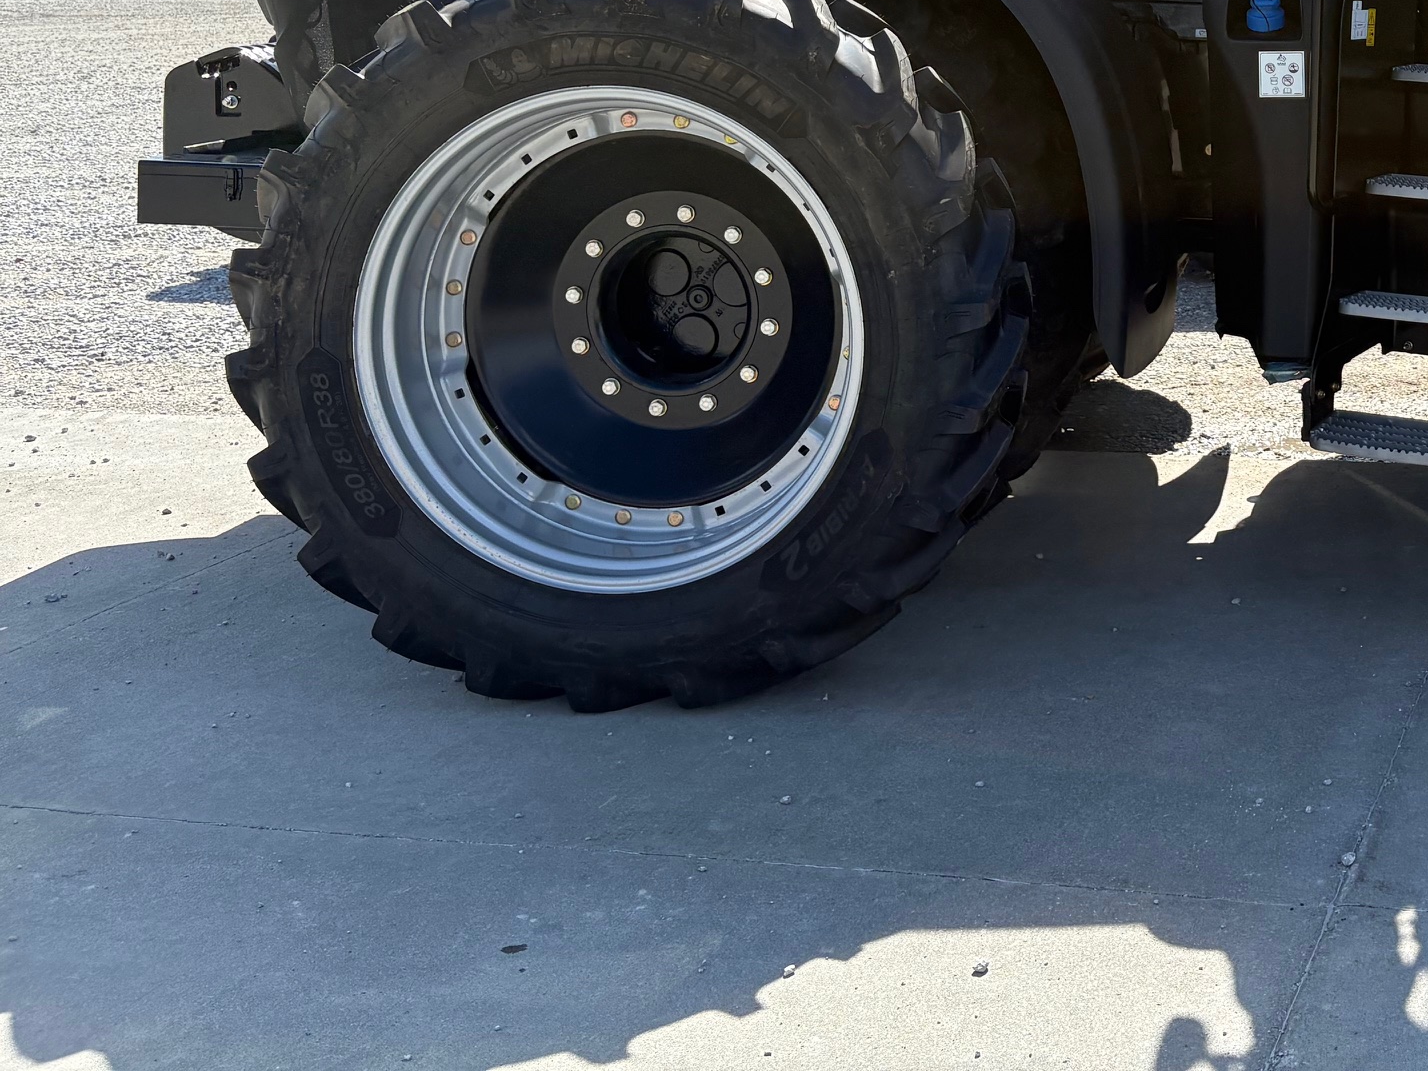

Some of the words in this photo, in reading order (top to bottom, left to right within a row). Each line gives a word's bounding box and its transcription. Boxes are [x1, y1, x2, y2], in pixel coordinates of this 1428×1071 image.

[550, 35, 796, 119] MICHELIN
[309, 372, 340, 428] R38
[325, 431, 385, 519] 380/80
[780, 539, 809, 581] 2
